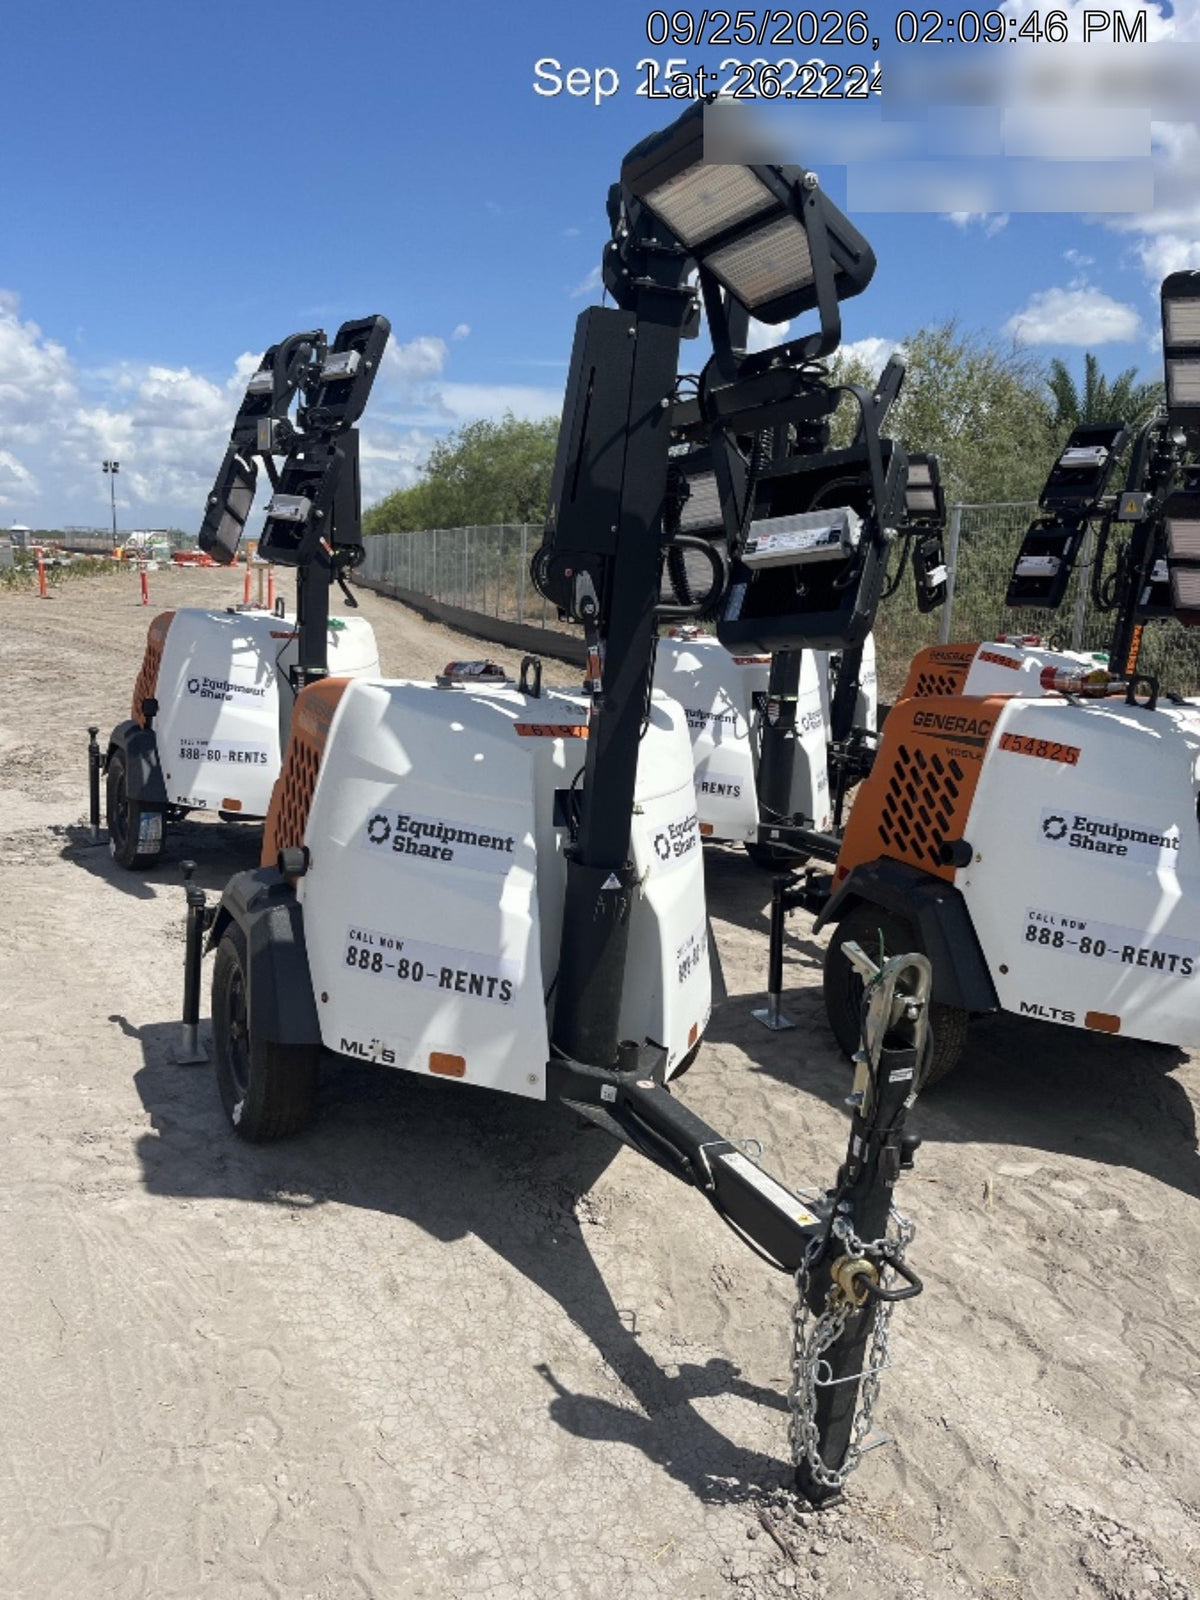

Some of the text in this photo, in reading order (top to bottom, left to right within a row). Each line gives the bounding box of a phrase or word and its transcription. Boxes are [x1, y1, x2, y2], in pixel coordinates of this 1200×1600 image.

[913, 711, 992, 736] GENERAC
[1000, 734, 1080, 764] 754825
[396, 815, 515, 853] Equipment
[1068, 832, 1128, 857] Share
[1072, 815, 1181, 851] Equipment
[392, 835, 454, 861] Share
[1028, 911, 1088, 931] CALL NOW
[349, 929, 405, 951] CALL NOW
[1025, 924, 1194, 976] 888-80-RENTS
[346, 945, 514, 1002] 888-80-RENTS
[1019, 1001, 1076, 1023] MLTS
